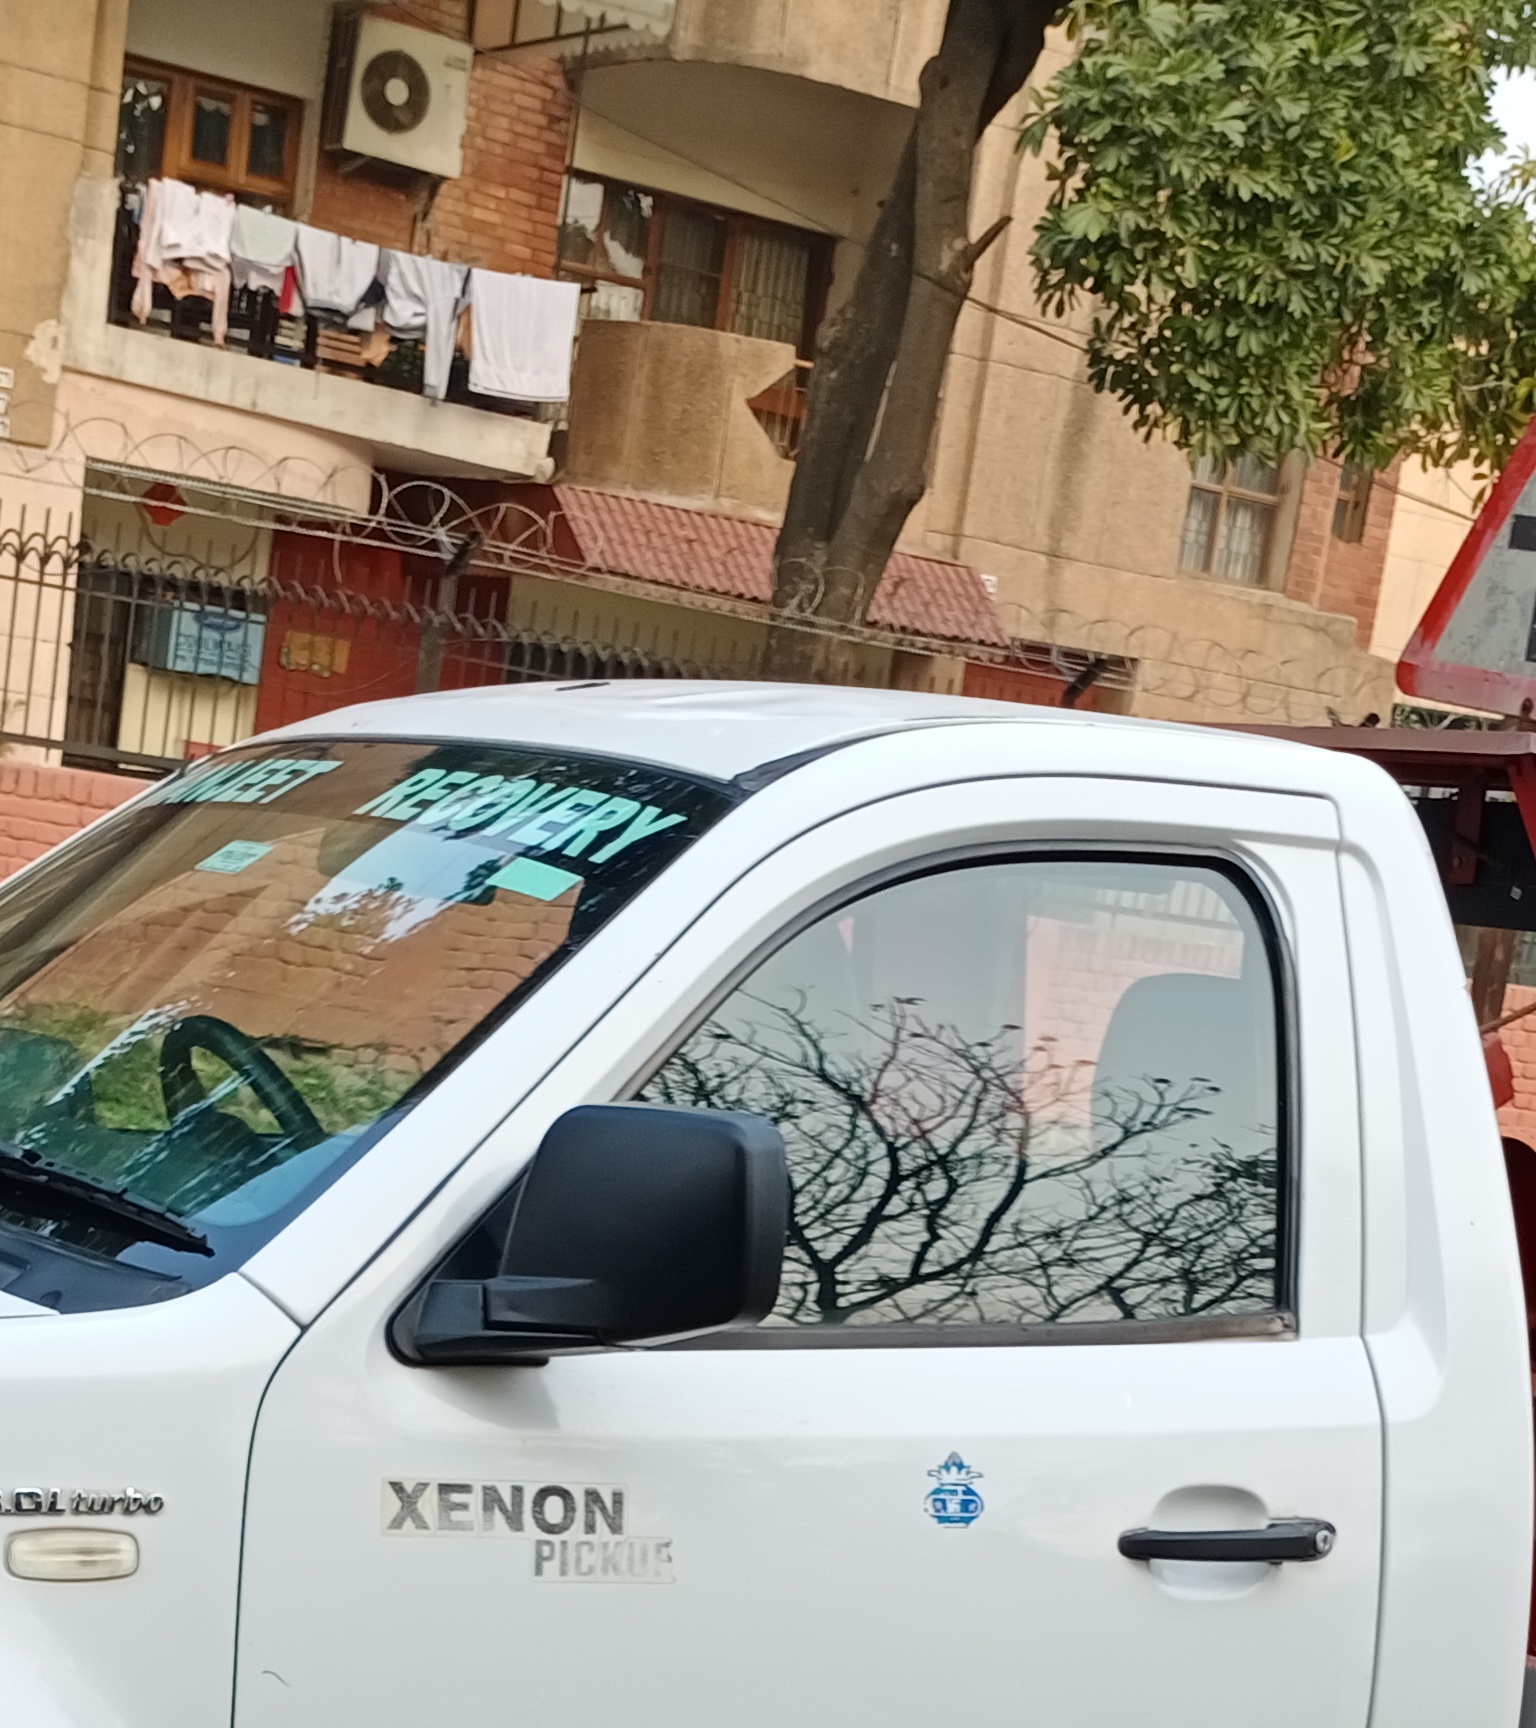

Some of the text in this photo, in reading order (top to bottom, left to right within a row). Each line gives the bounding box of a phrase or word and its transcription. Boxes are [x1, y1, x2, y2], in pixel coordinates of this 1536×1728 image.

[354, 768, 687, 864] RECOVERY
[68, 1485, 165, 1517] turbo
[385, 1480, 625, 1536] XENON
